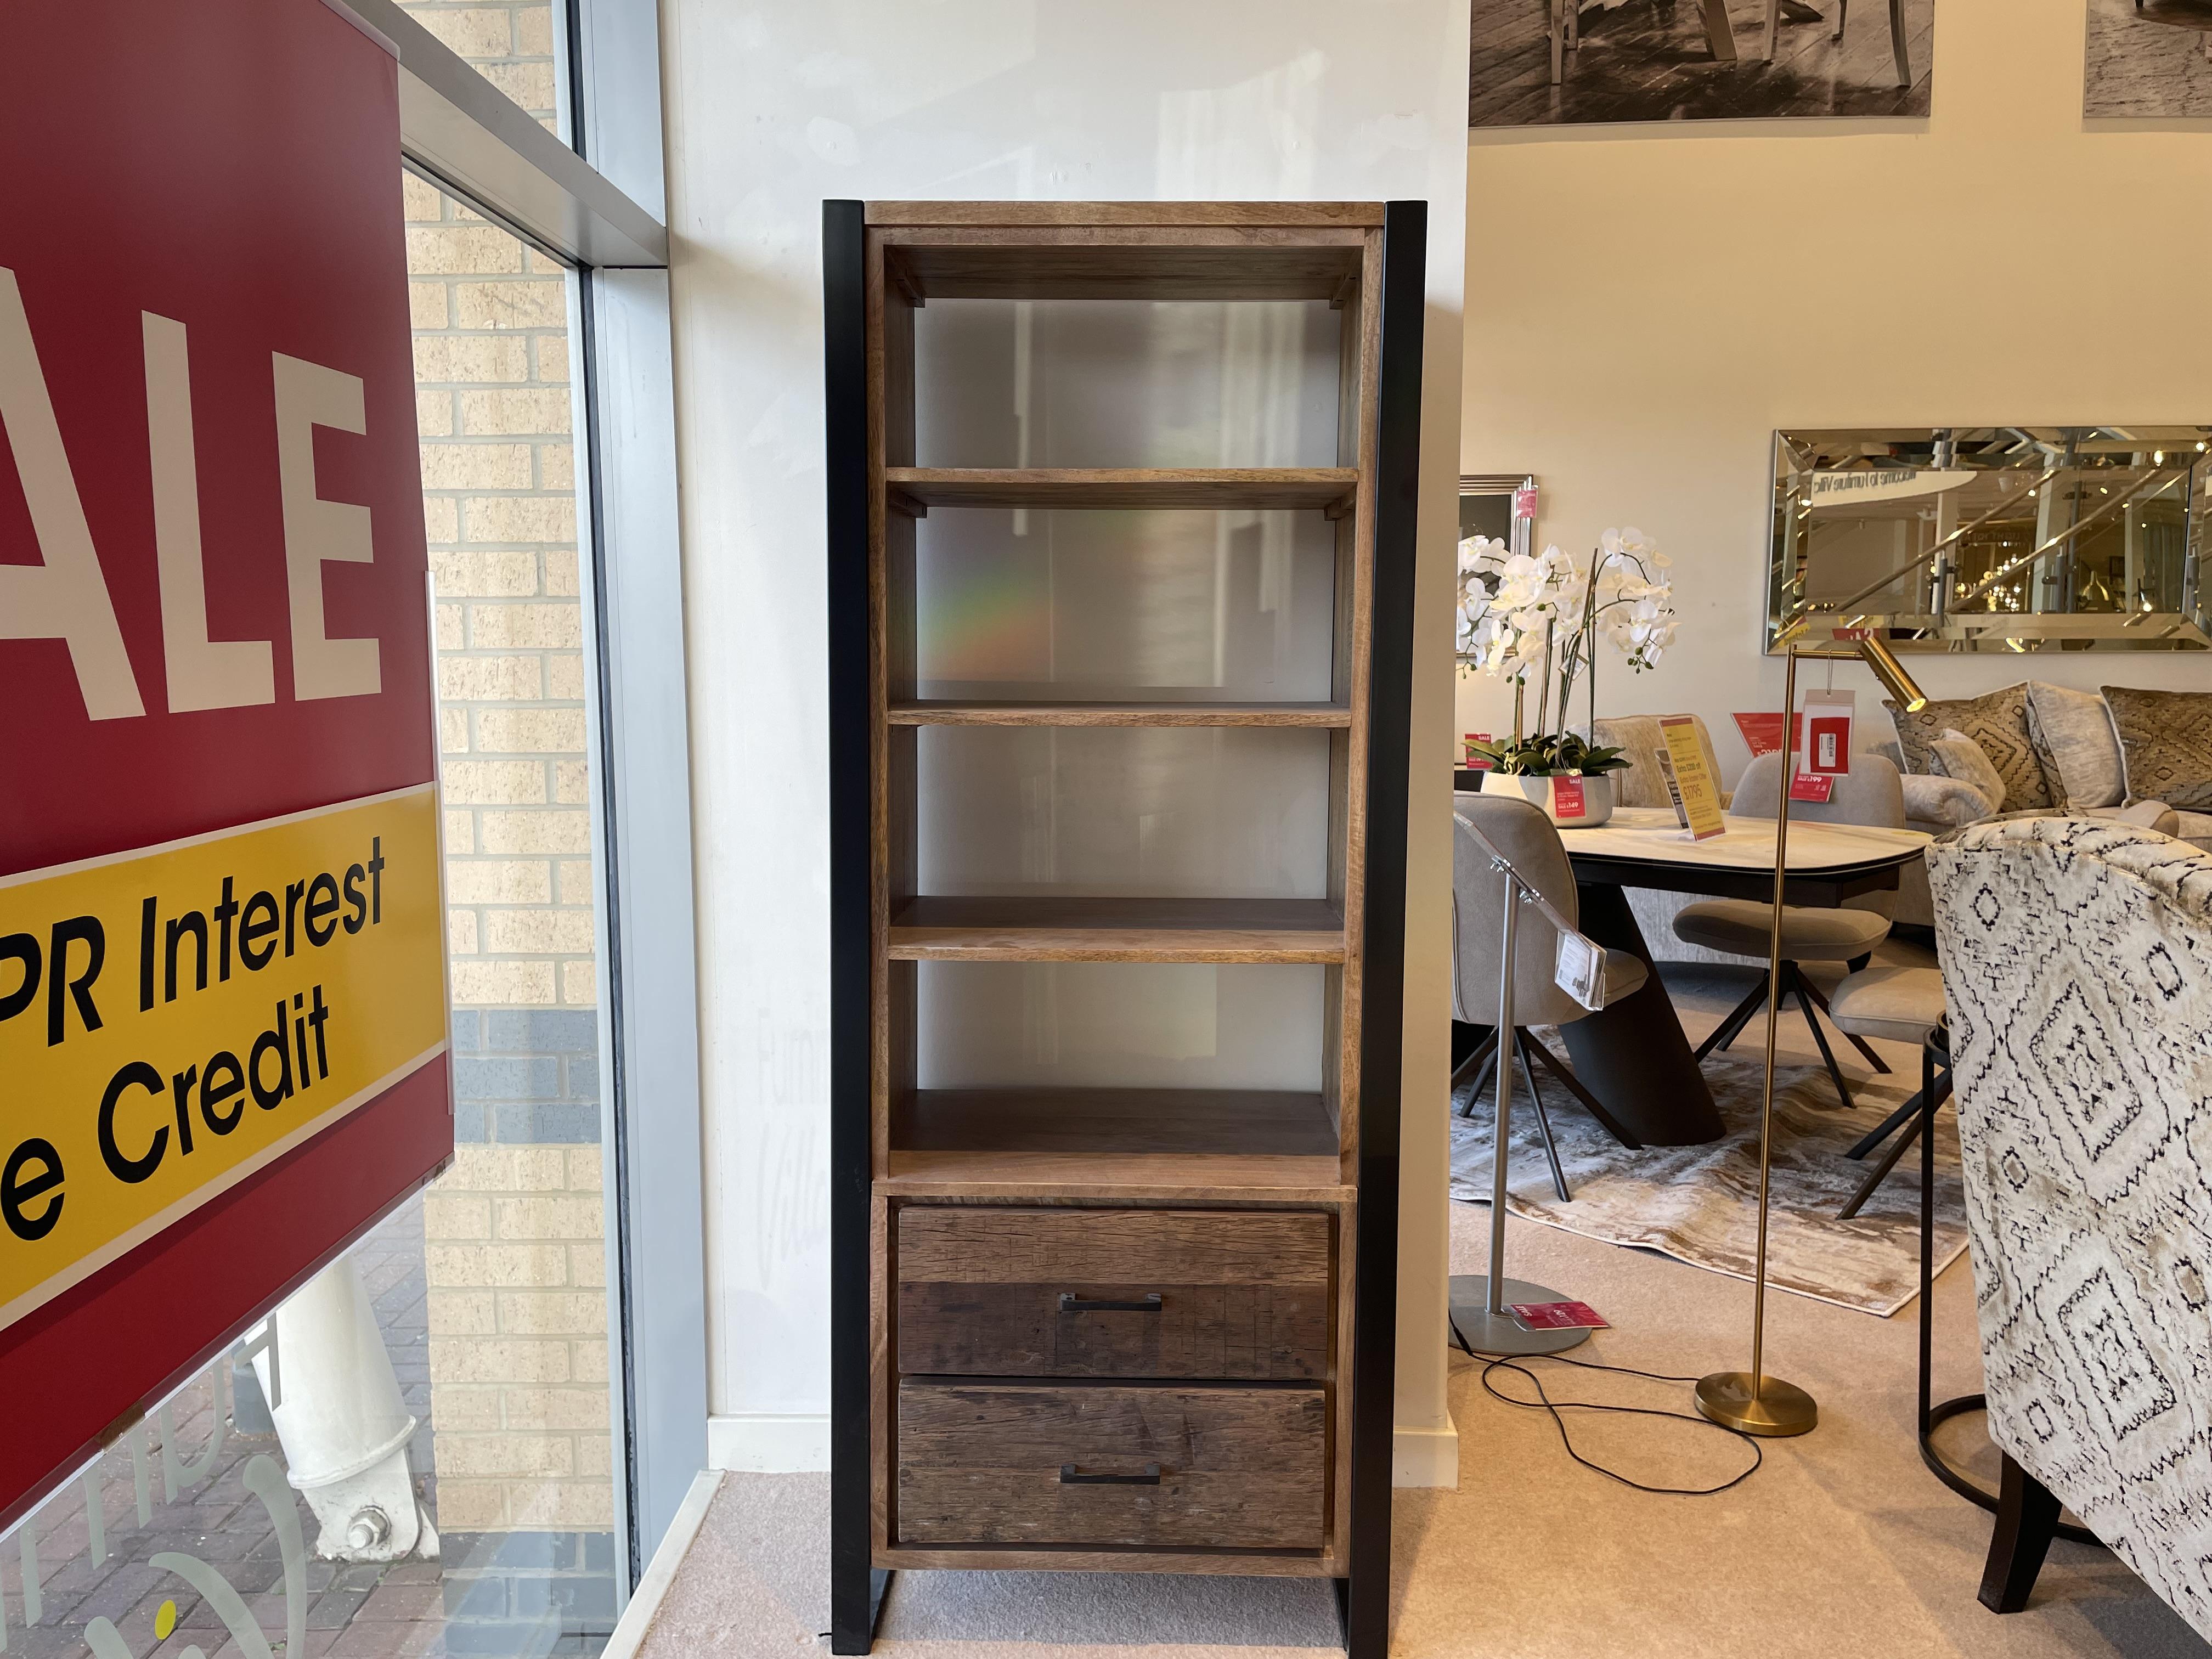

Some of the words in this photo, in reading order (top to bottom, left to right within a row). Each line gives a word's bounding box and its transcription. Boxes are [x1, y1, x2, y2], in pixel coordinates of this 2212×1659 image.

[140, 836, 385, 1013] Interest
[1, 1137, 65, 1242] e
[98, 984, 329, 1184] Credit
